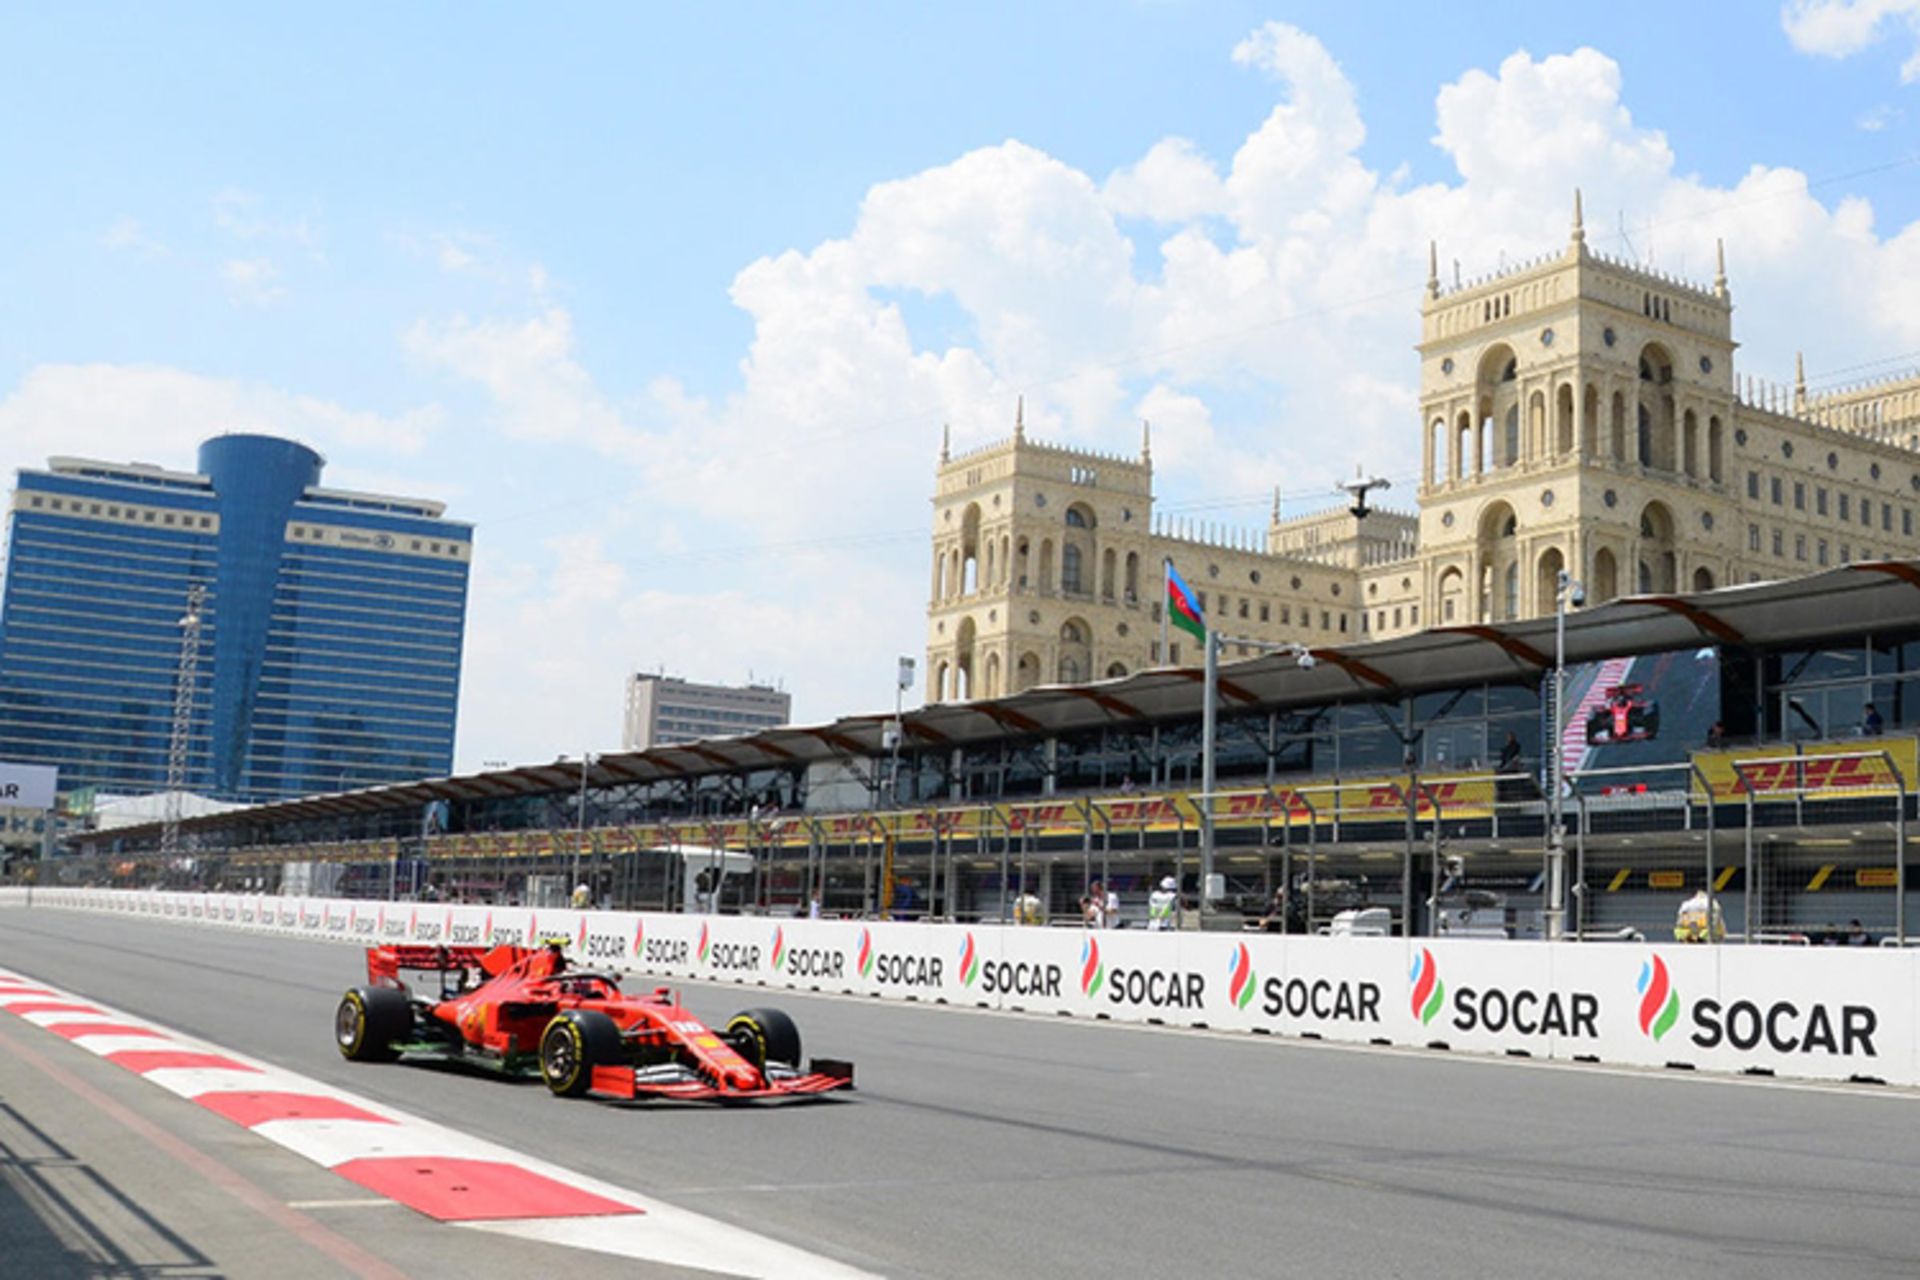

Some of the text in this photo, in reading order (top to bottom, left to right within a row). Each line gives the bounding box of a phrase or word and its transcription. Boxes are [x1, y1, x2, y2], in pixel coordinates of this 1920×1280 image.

[645, 938, 689, 964] SOCAR
[711, 943, 761, 972] SOCAR
[787, 948, 844, 979] SOCAR
[876, 953, 943, 988] SOCAR
[981, 960, 1062, 998] SOCAR
[1108, 968, 1205, 1009] SOCAR
[1262, 977, 1381, 1023] SOCAR
[1452, 987, 1599, 1039] SOCAR
[1690, 998, 1878, 1057] SOCAR
